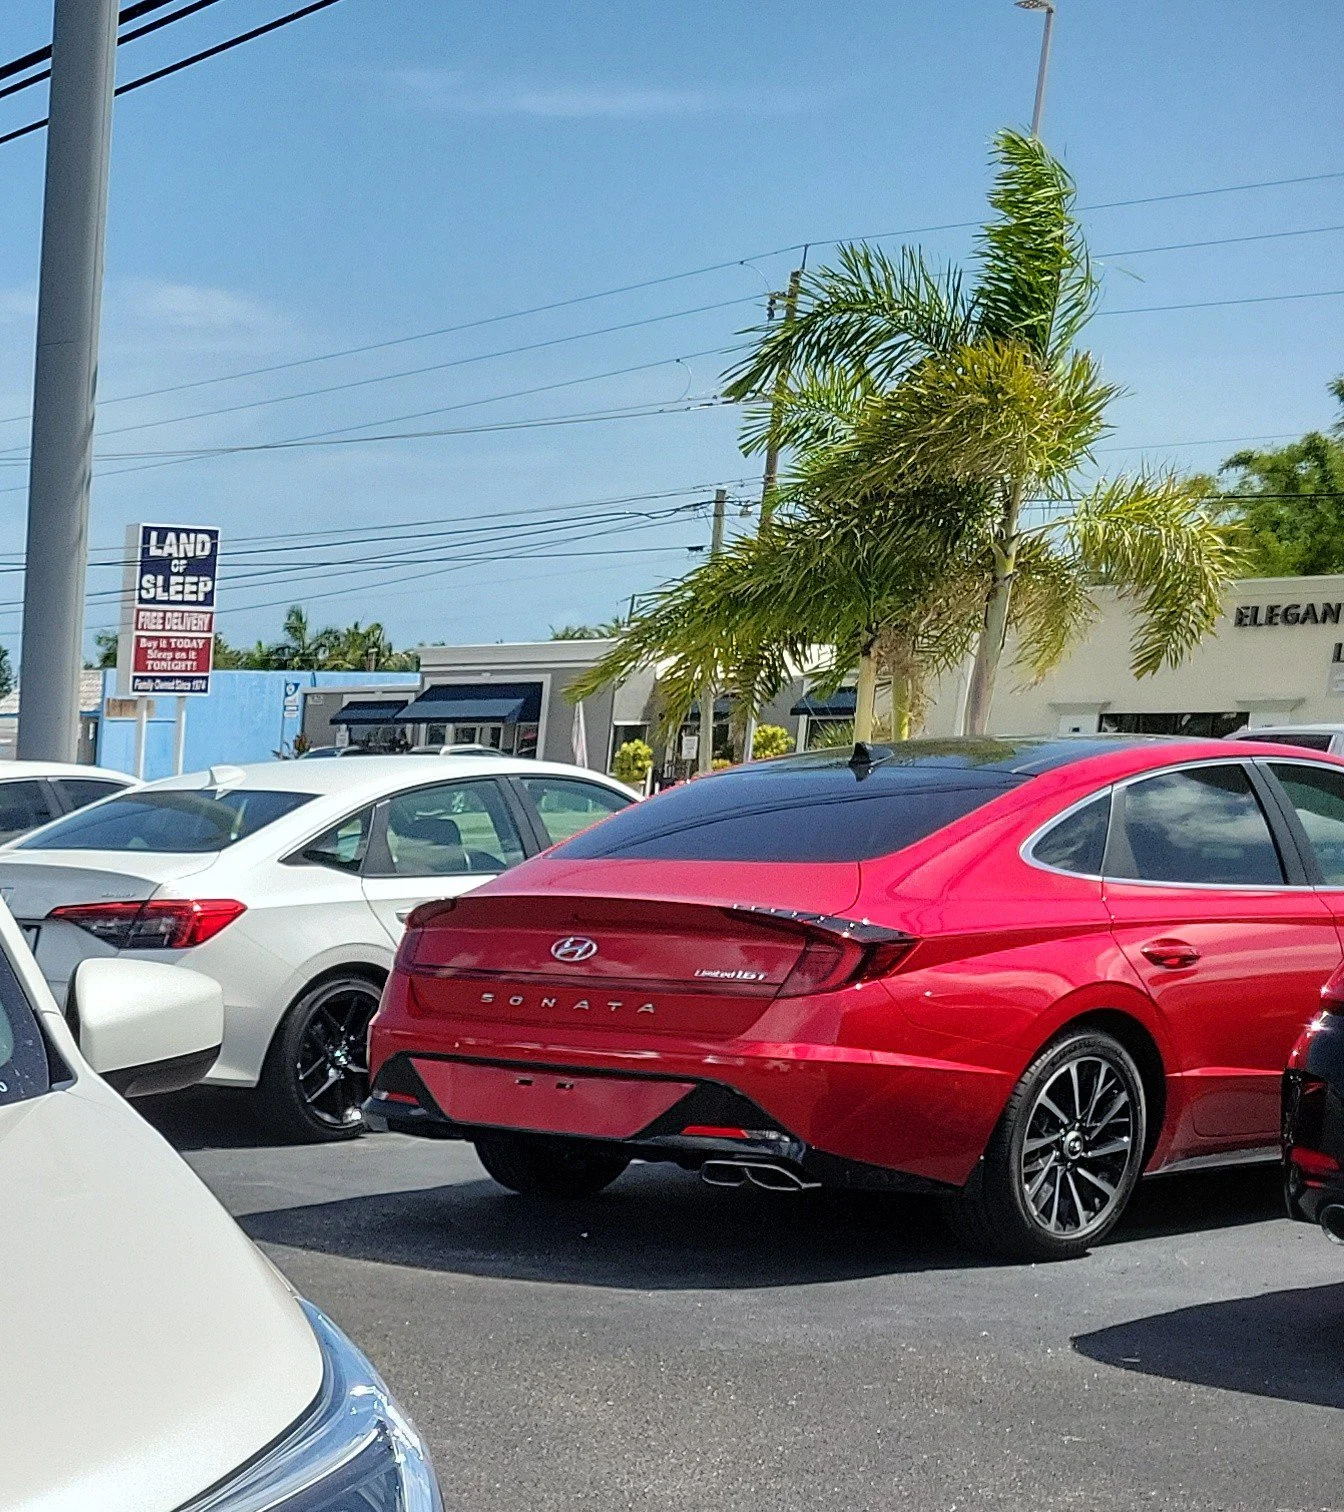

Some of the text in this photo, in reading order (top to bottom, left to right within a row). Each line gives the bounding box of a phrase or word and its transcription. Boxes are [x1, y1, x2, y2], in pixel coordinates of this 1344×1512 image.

[149, 531, 211, 558] LAND
[170, 559, 188, 573] OF
[141, 574, 213, 601] SLEEP
[138, 611, 210, 631] FREE DELIVERY
[1233, 602, 1344, 627] ELEGAN
[139, 638, 205, 650] Buy it TODAY
[146, 649, 173, 660] Sleep
[188, 649, 197, 659] it
[146, 660, 198, 671] TONIGHT!
[693, 968, 736, 979] Limited
[479, 992, 657, 1015] SONATA
